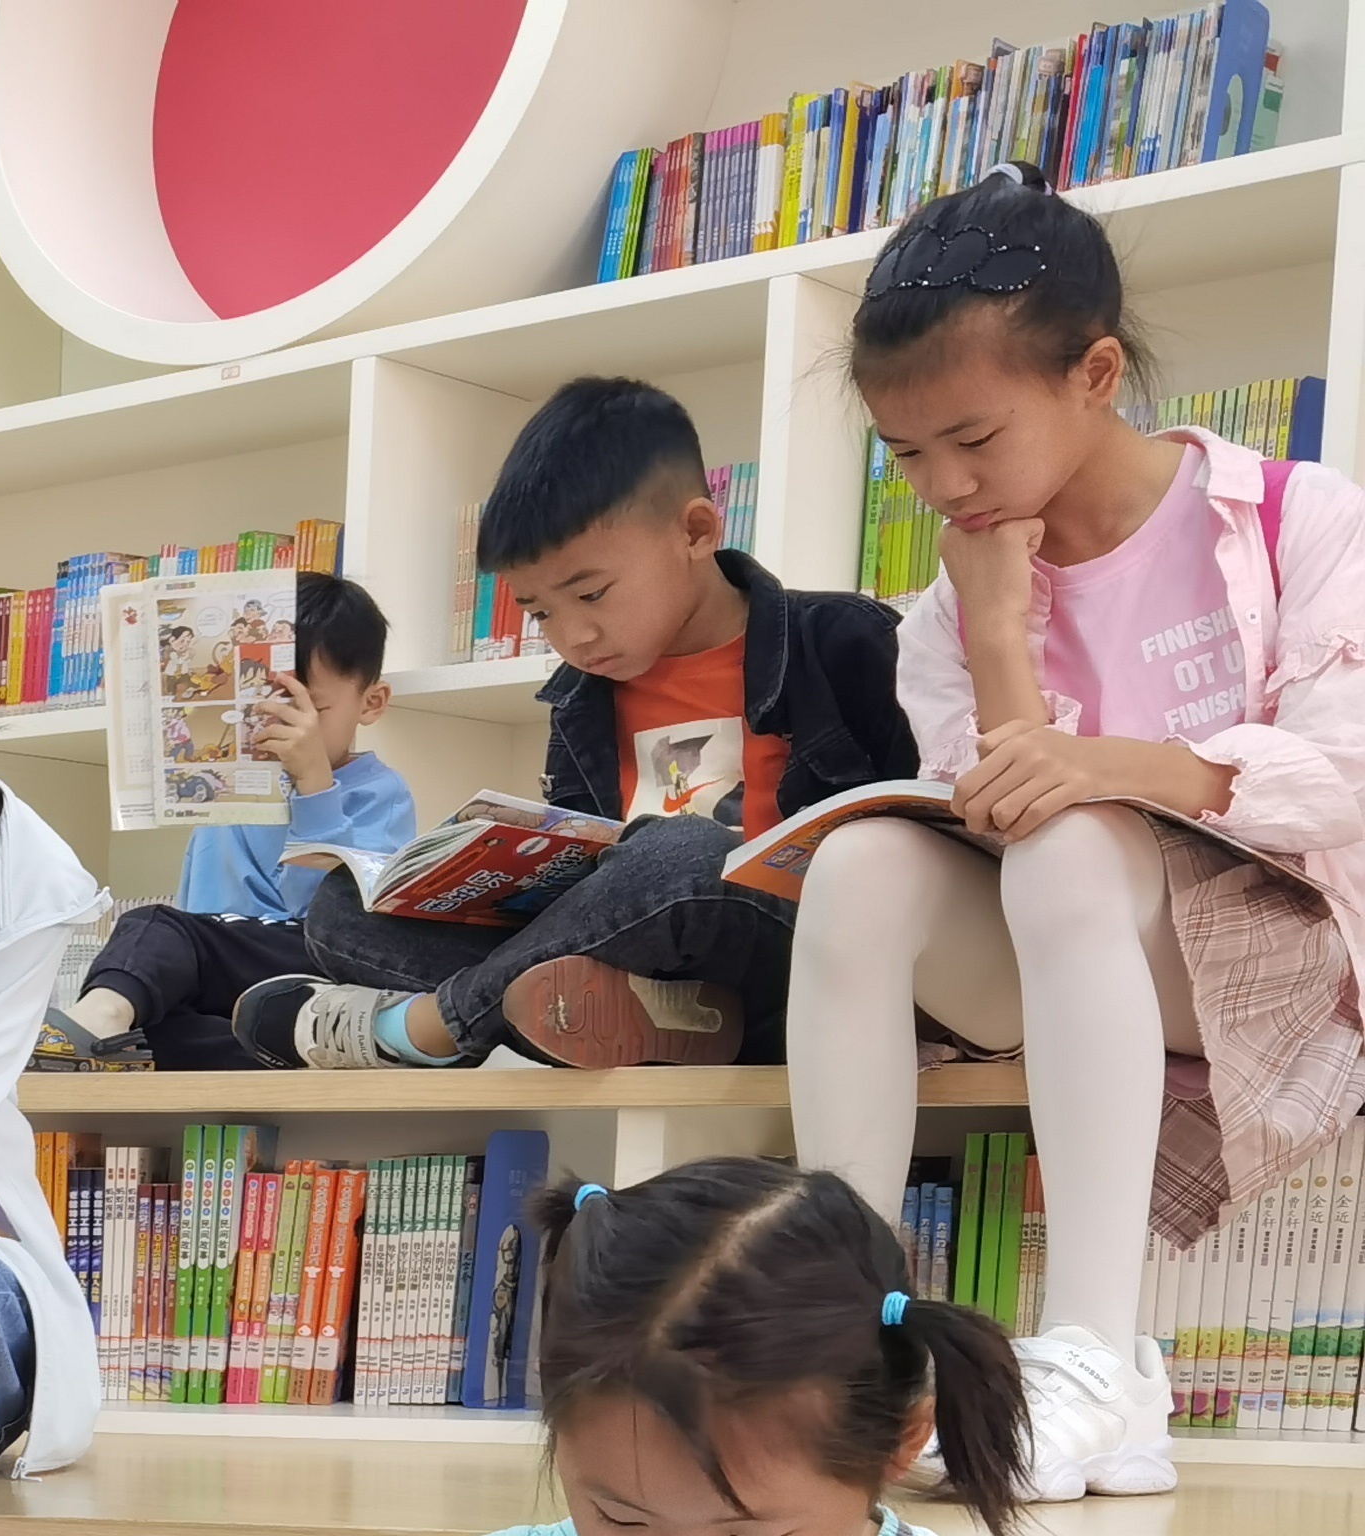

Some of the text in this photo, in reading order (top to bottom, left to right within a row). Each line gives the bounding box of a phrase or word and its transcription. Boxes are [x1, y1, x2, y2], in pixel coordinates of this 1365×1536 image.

[1173, 651, 1215, 692] OT
[1310, 1194, 1327, 1224] 金近
[1335, 1194, 1352, 1224] 金近
[1077, 1361, 1110, 1389] BOBDOG
